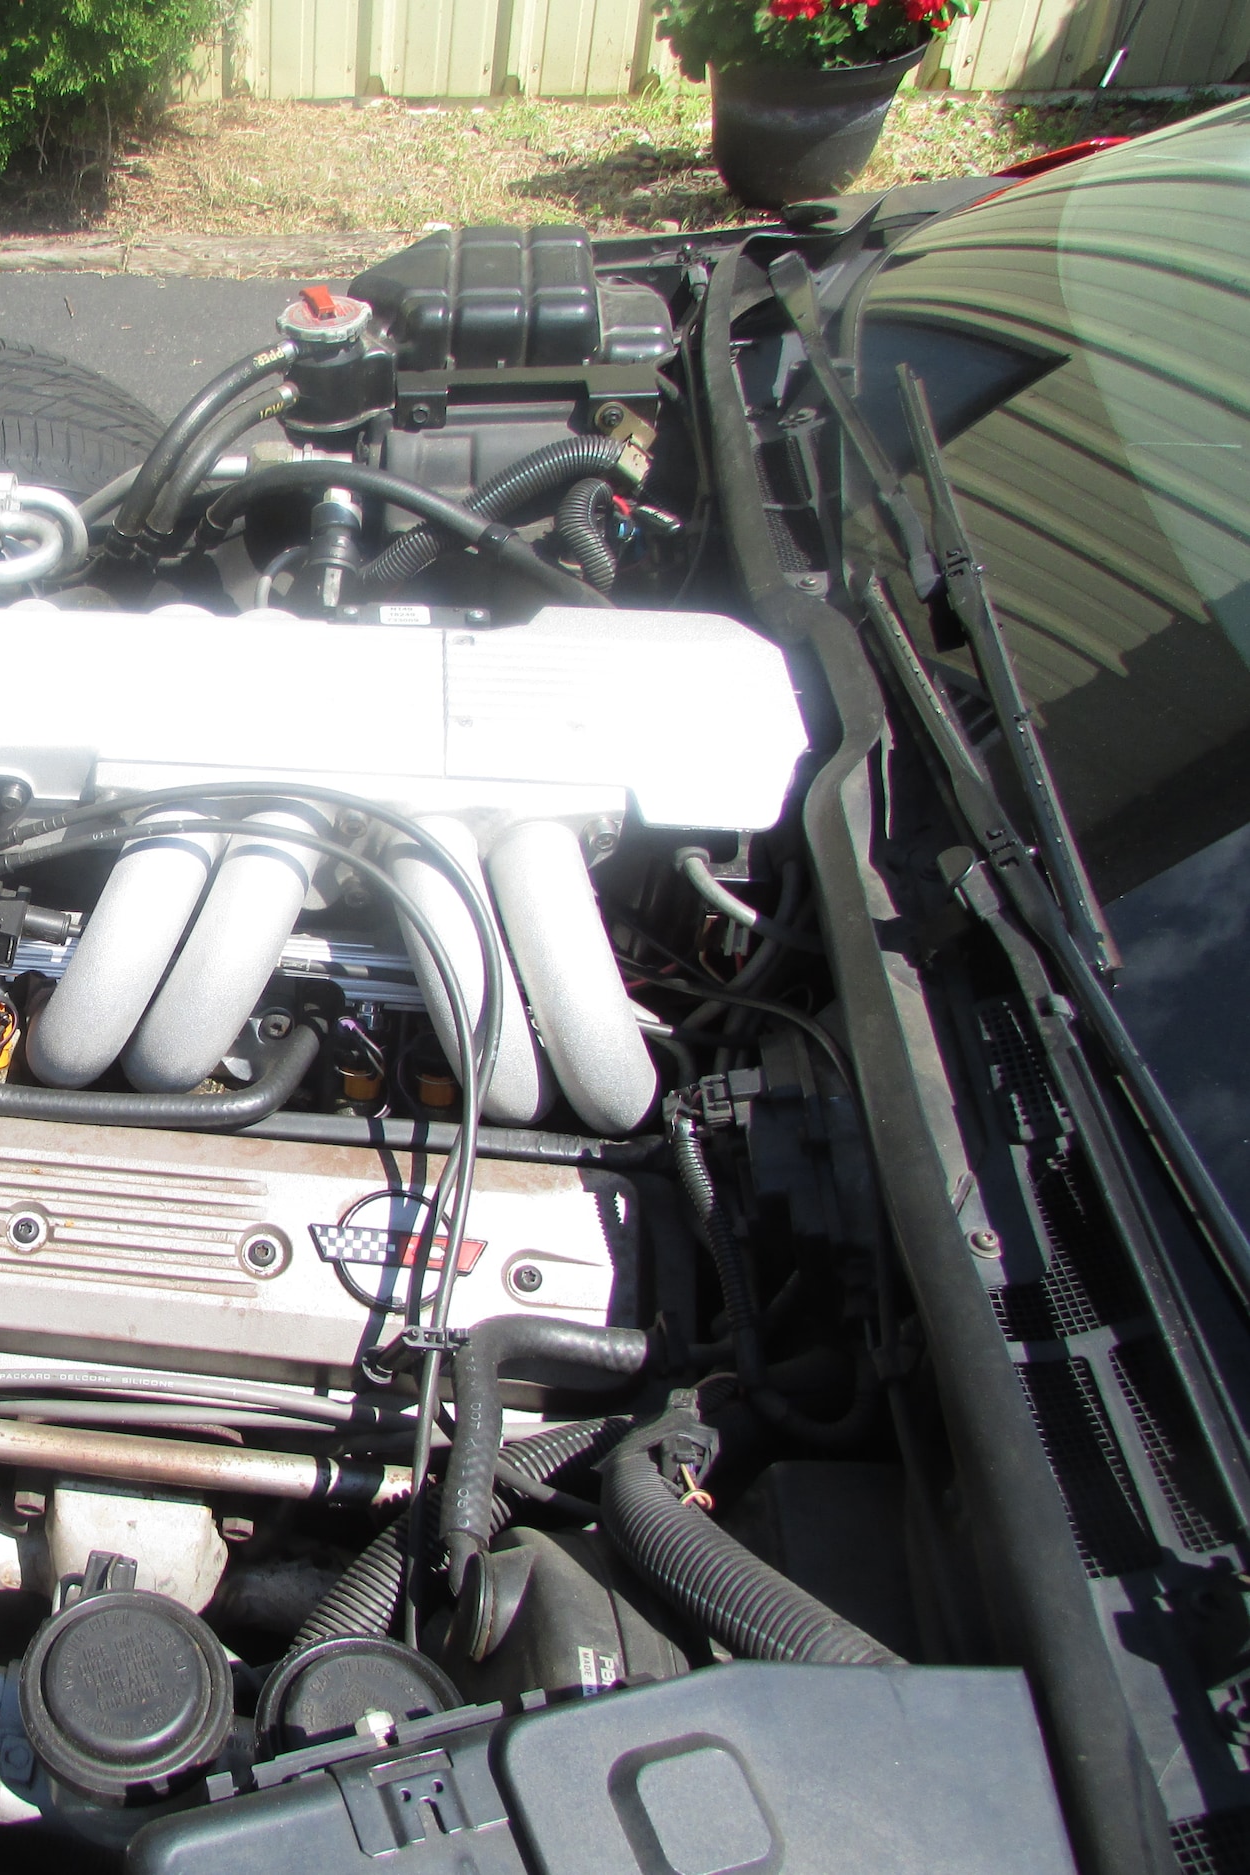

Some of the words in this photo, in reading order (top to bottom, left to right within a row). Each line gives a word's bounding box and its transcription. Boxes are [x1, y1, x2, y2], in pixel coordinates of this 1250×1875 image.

[254, 346, 284, 366] PPER
[0, 1373, 51, 1381] PACKARD
[121, 1376, 174, 1388] SILICONE
[581, 1651, 592, 1678] MADE
